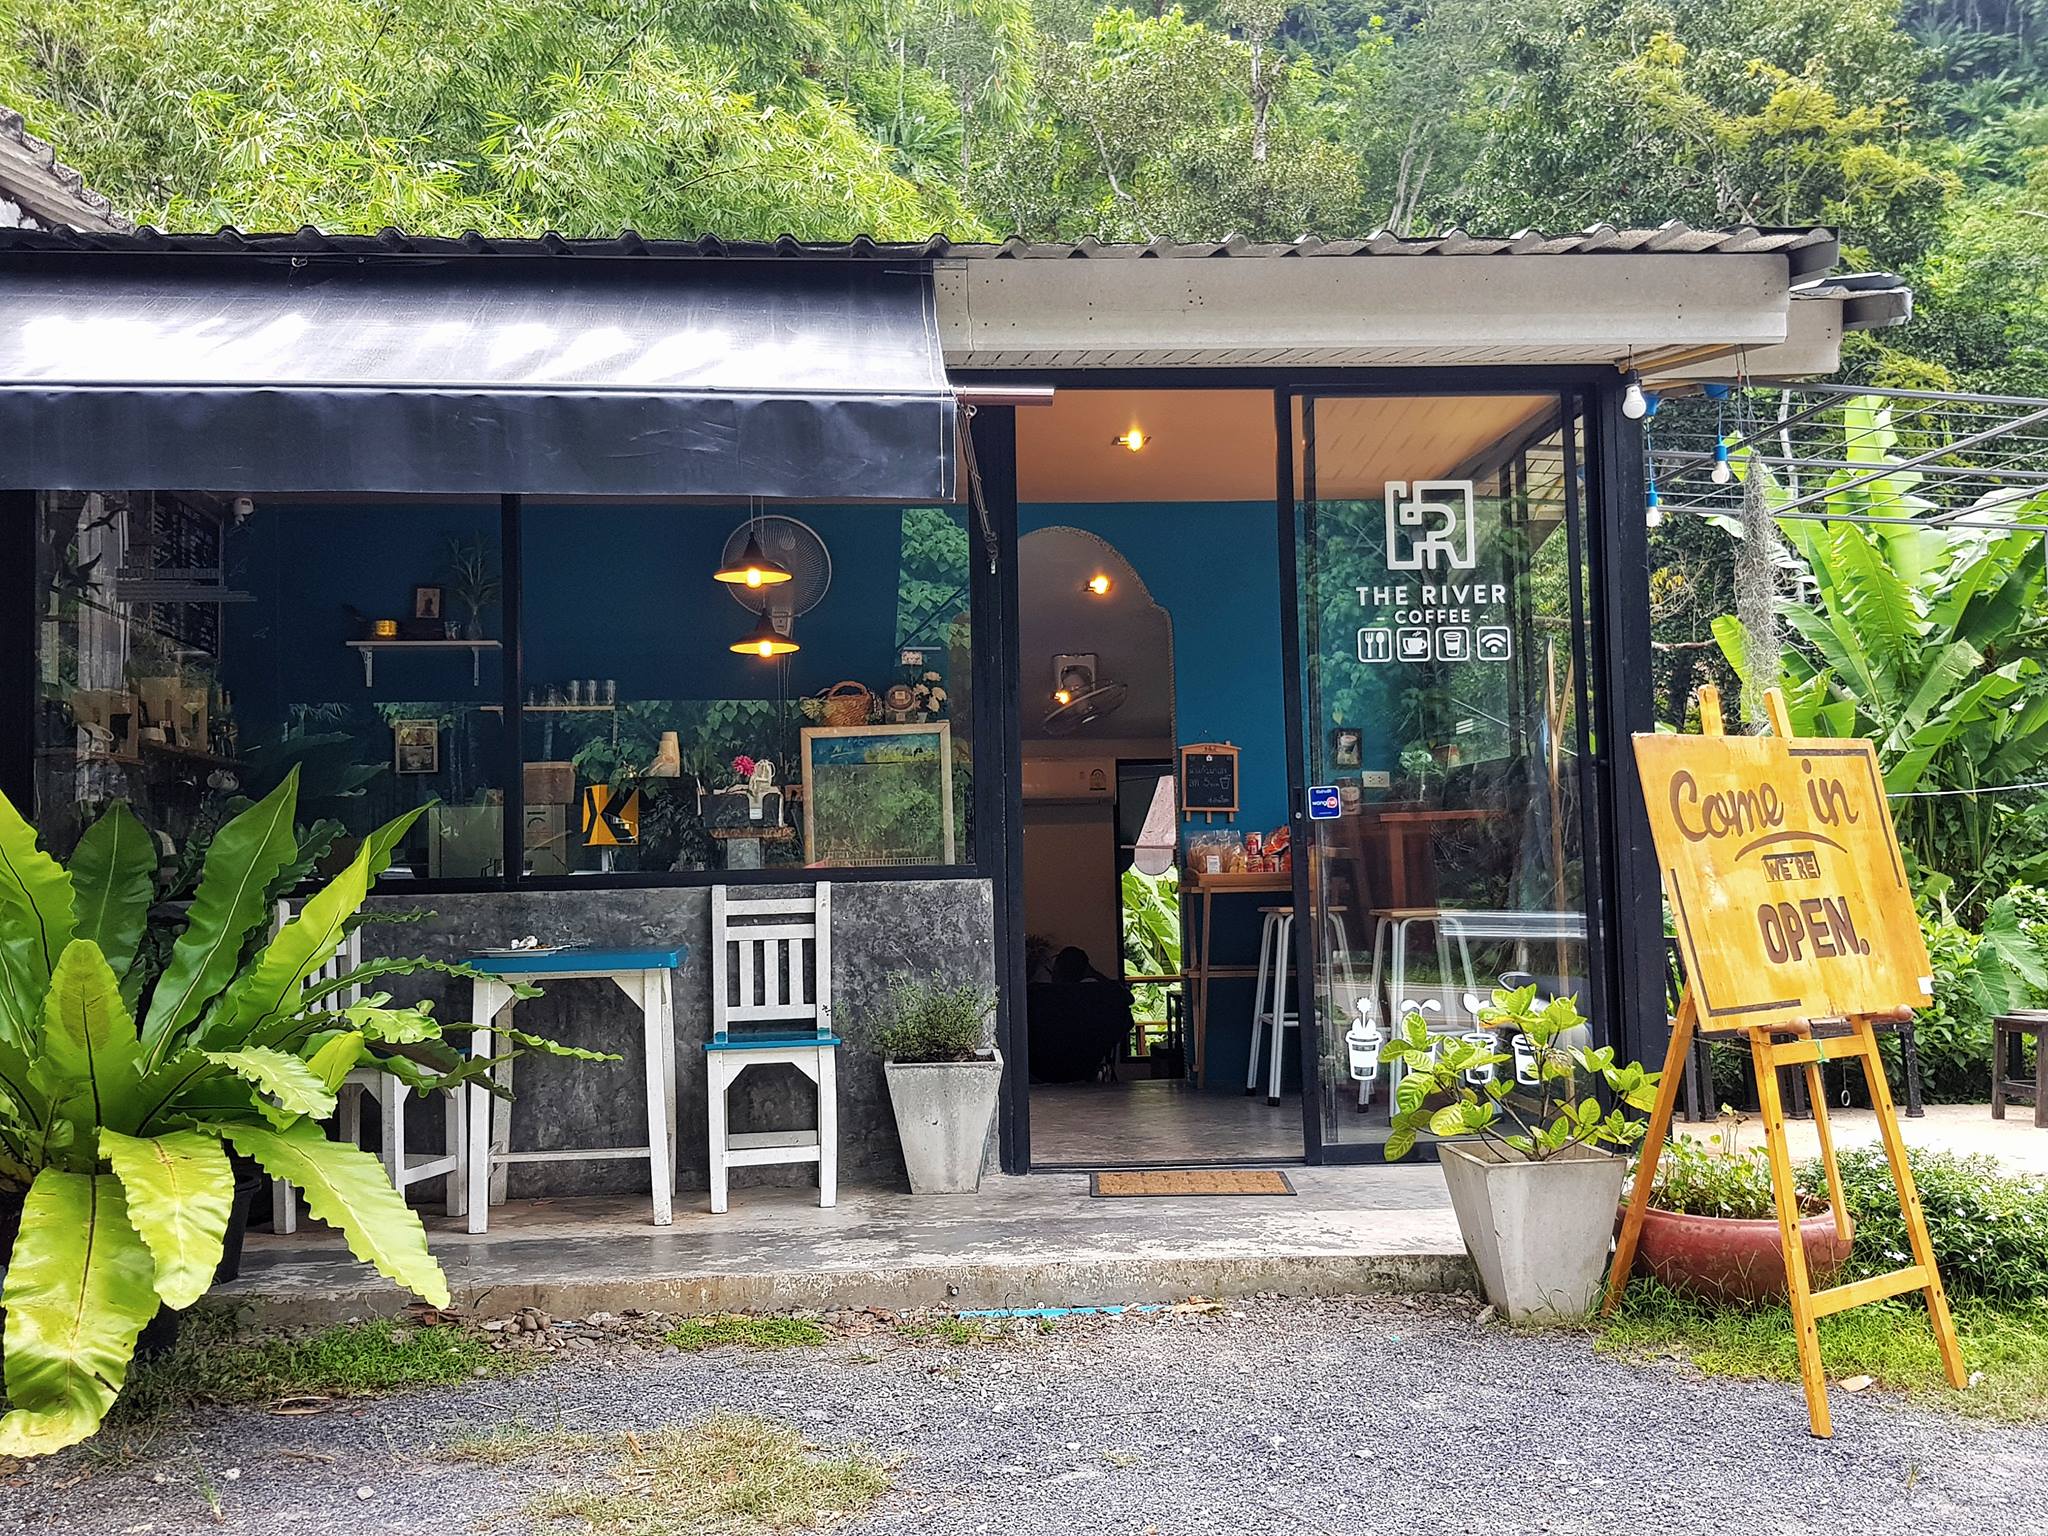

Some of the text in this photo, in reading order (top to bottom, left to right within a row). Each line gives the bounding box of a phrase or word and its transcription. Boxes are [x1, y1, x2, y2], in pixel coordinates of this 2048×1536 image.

[1355, 584, 1506, 606] THE RIVER
[1394, 609, 1471, 624] COFFEE
[1669, 758, 1859, 843] Come in
[1763, 856, 1820, 881] WE'RE
[1757, 895, 1871, 964] OPEN.
